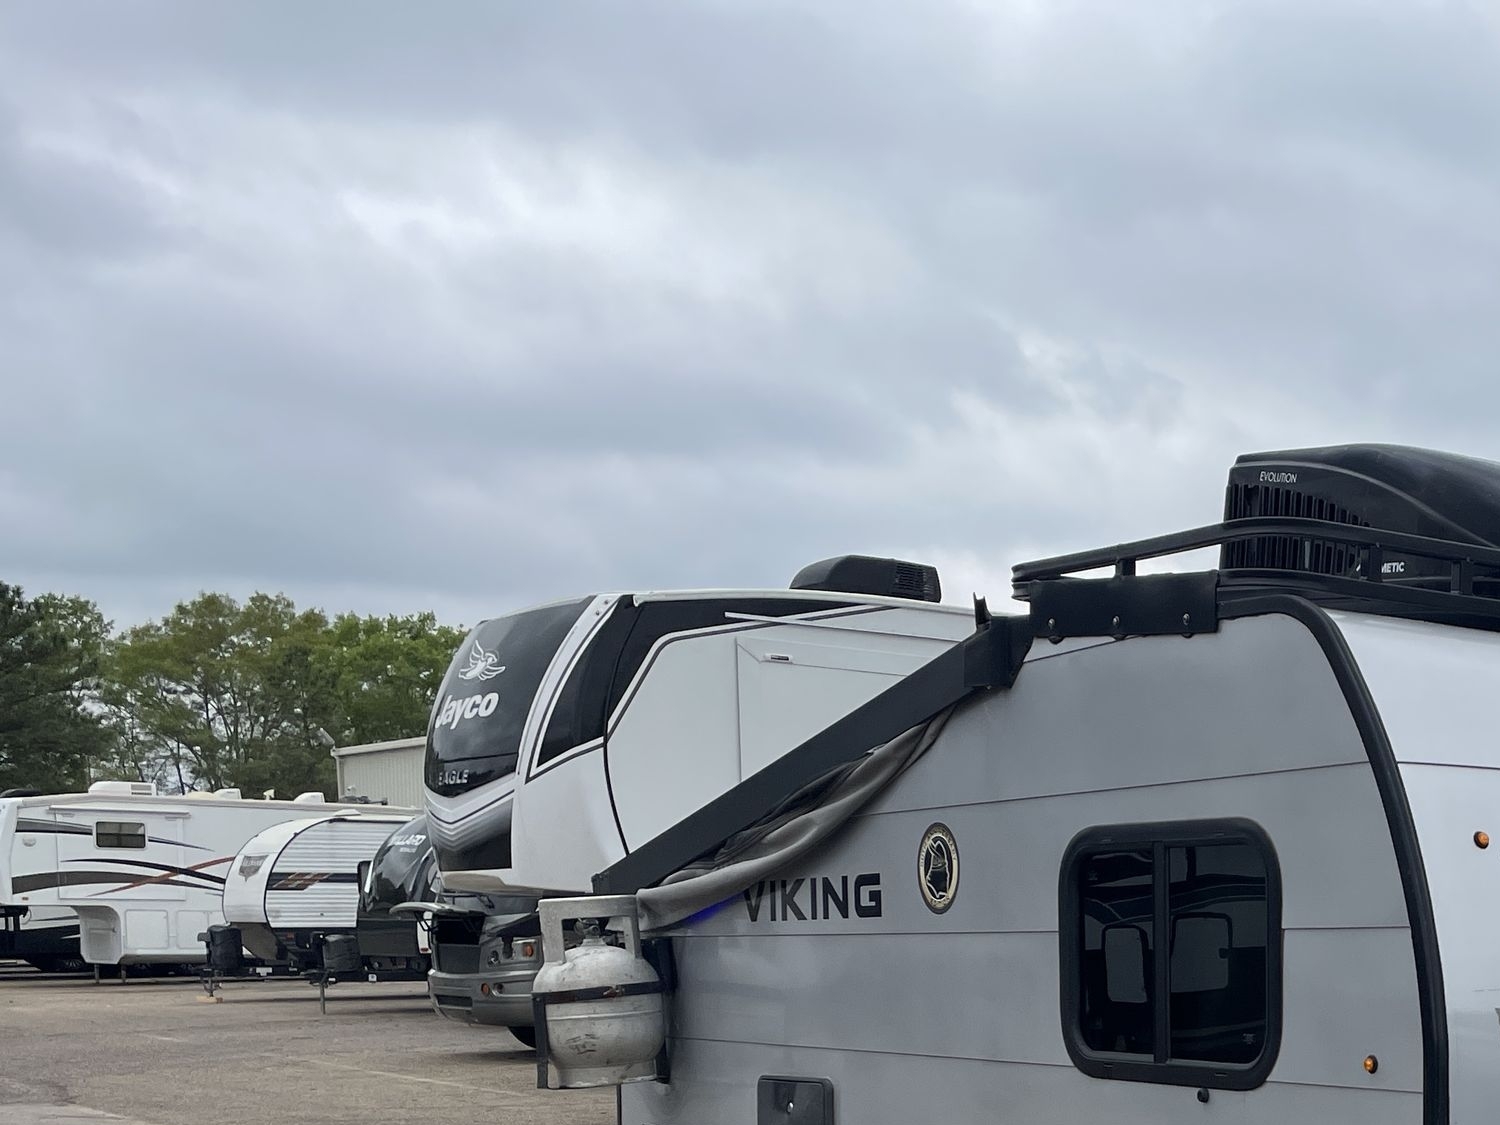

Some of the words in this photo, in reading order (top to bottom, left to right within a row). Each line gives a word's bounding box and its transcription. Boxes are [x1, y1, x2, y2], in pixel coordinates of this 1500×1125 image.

[1260, 471, 1297, 483] EVOLUTION
[435, 693, 499, 729] Jayco
[438, 769, 469, 785] EAGLE
[743, 873, 882, 922] VIKING
